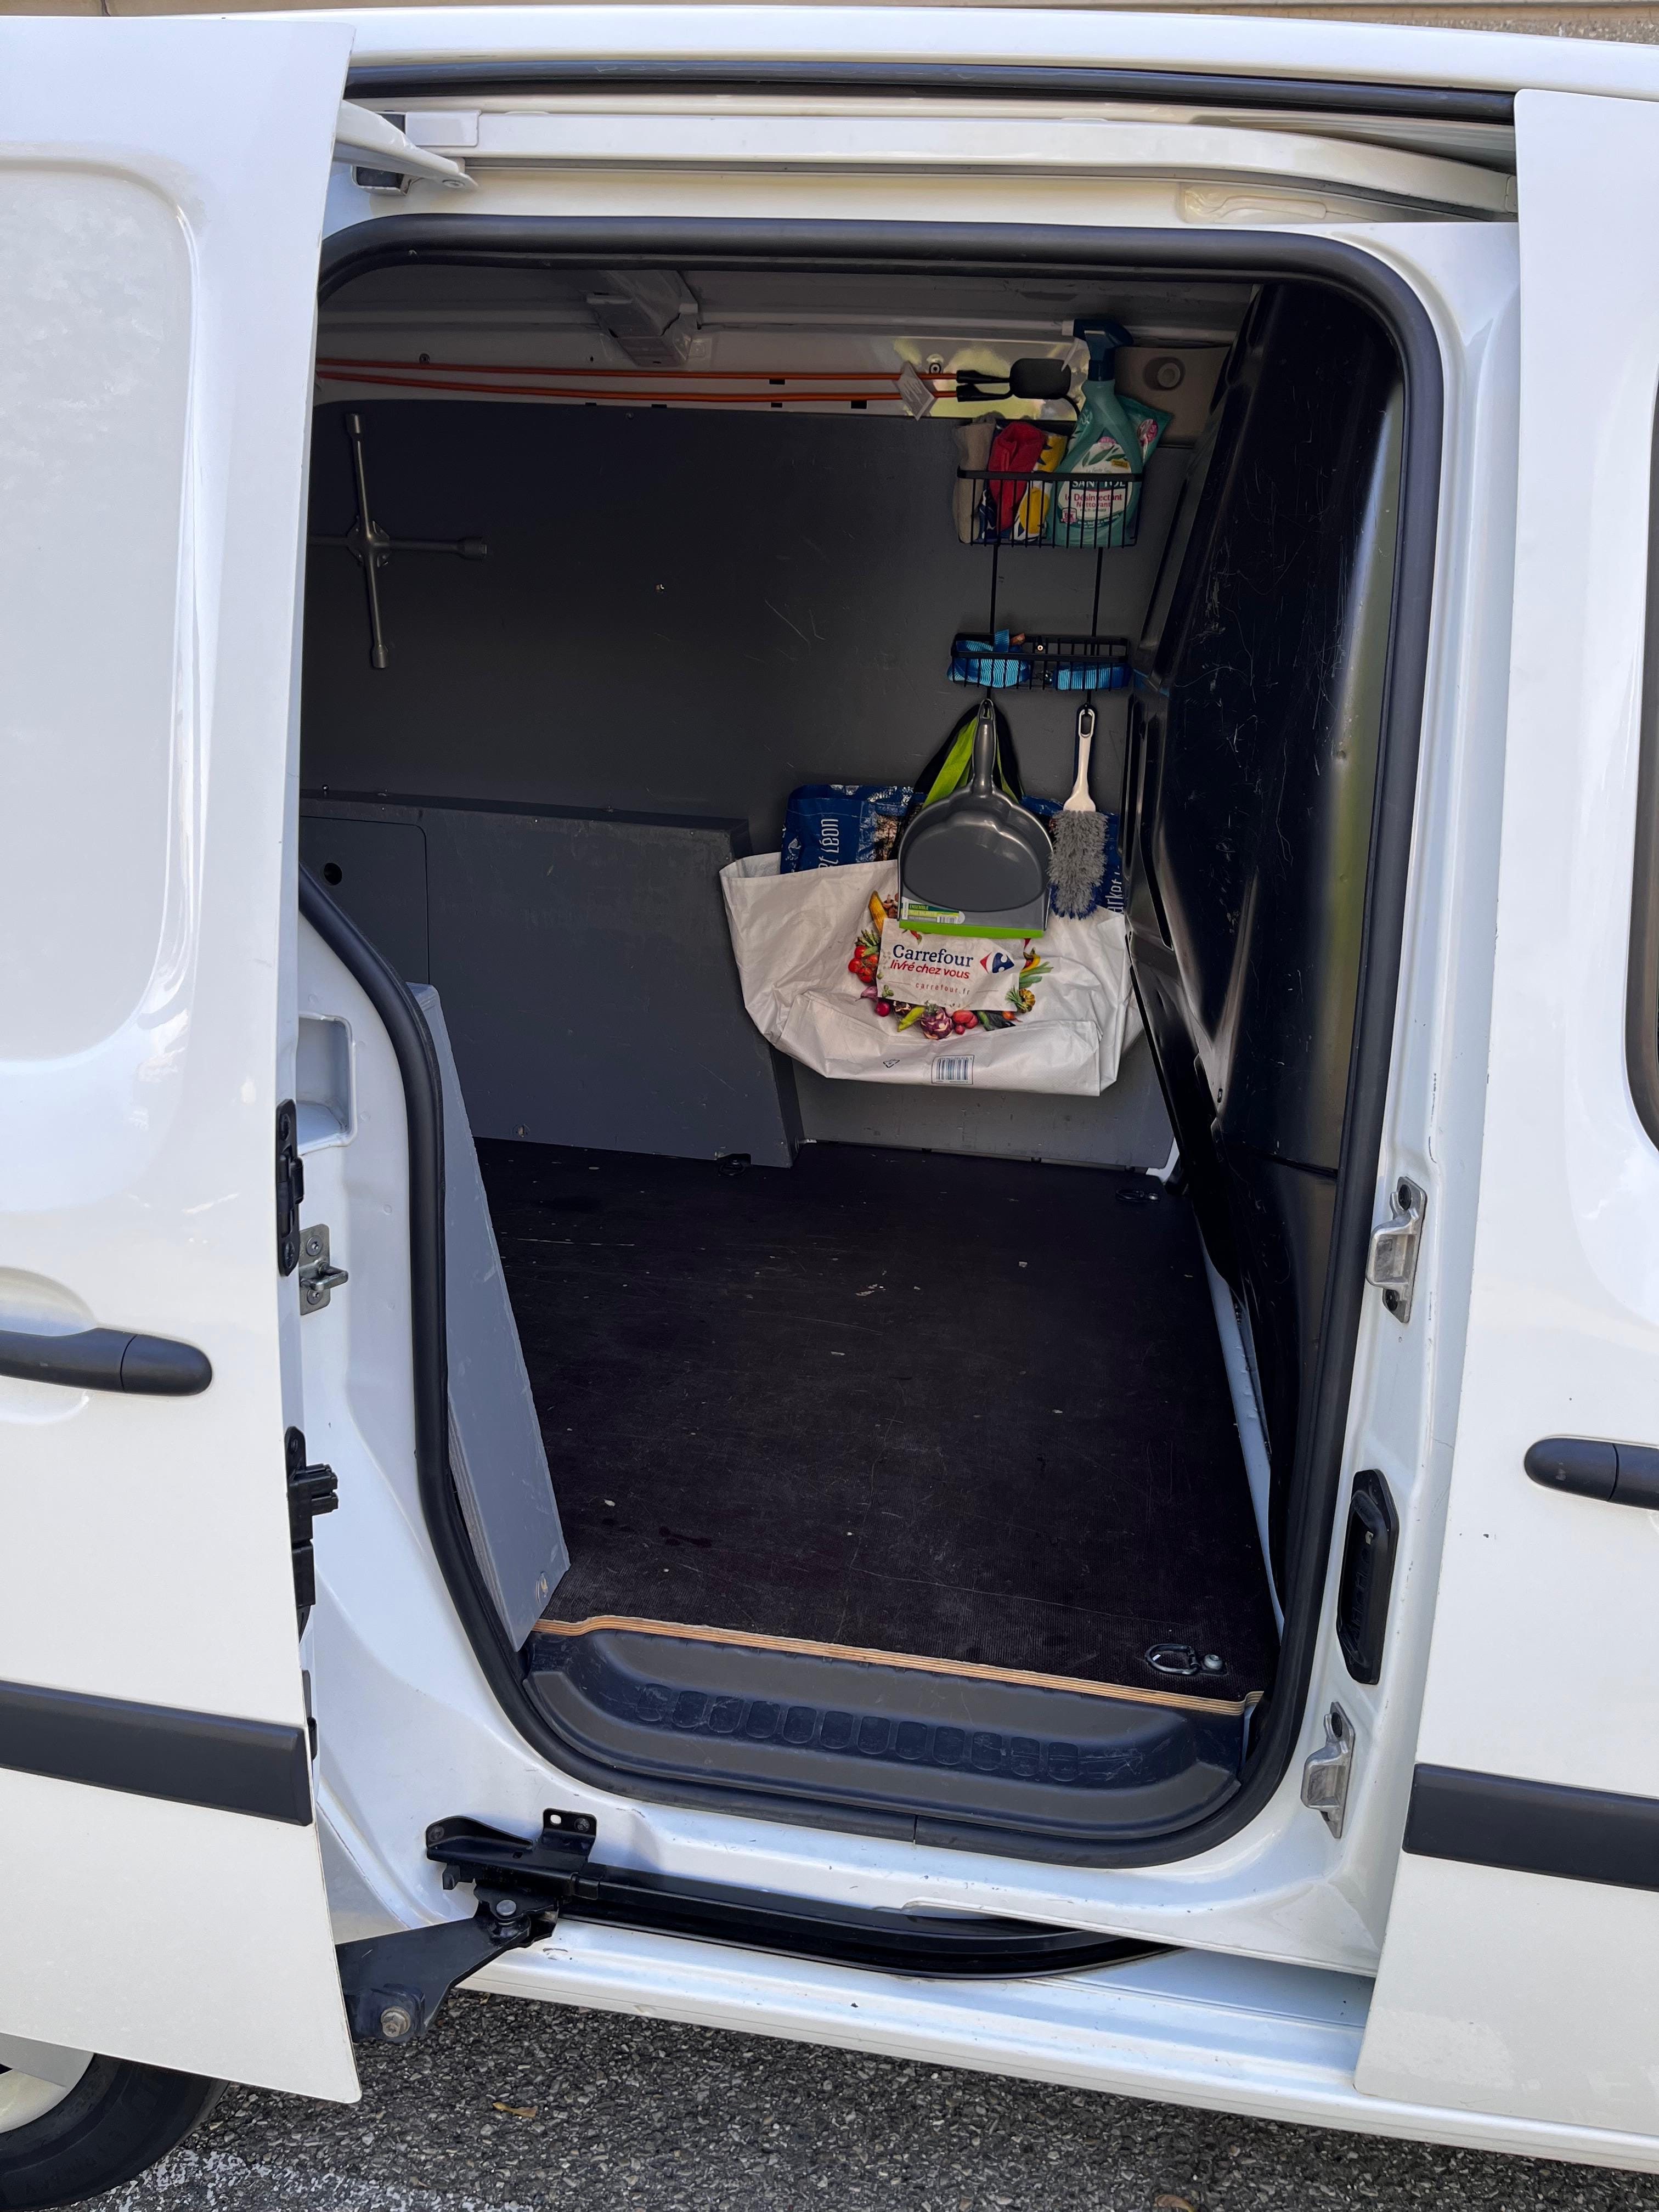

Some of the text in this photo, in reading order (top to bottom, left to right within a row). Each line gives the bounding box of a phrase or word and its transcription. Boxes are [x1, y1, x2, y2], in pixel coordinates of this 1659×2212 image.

[819, 819, 839, 853] Léon
[893, 944, 974, 967] Carrefour
[890, 960, 970, 979] livré chez vous
[916, 982, 970, 995] carrefour.fr
